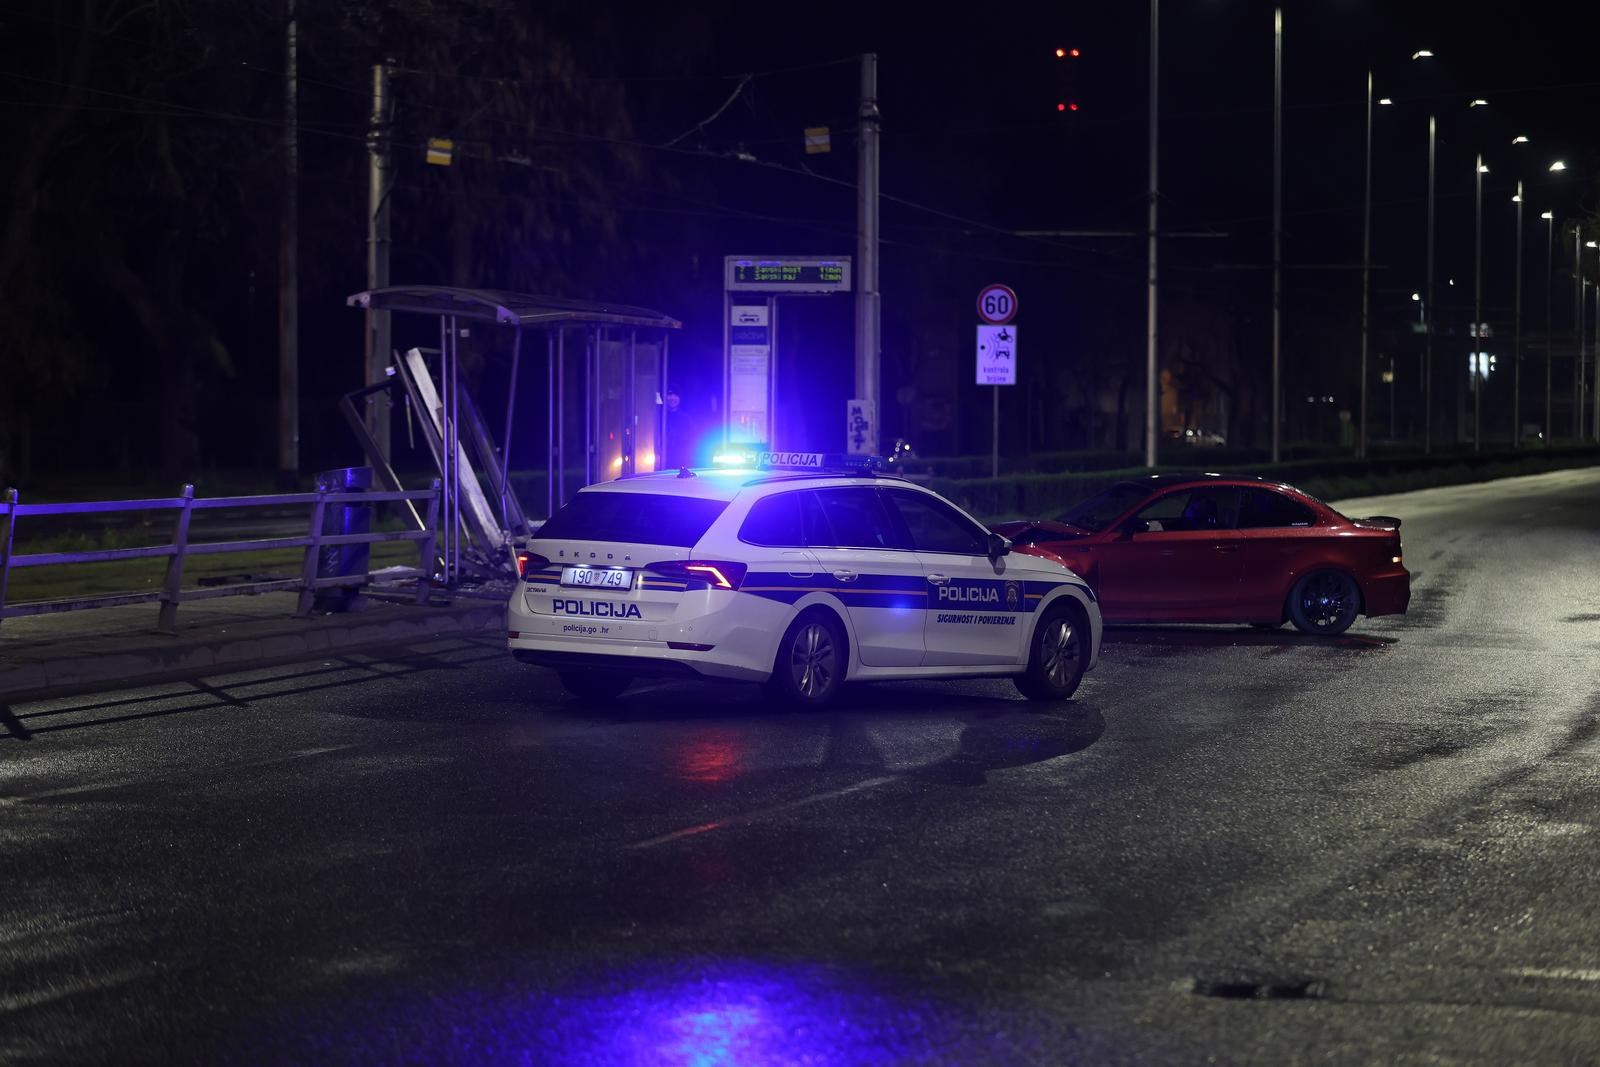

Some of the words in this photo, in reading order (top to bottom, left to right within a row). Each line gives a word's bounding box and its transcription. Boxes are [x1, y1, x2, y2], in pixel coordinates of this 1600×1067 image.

[985, 295, 1009, 315] 60
[762, 453, 818, 466] POLICIJA
[571, 570, 592, 584] 190
[600, 571, 623, 586] 749
[938, 586, 1000, 602] POLICIJA
[552, 599, 642, 619] POLICIJA
[937, 614, 974, 624] SIGURNOST
[977, 615, 1016, 625] POVJERENJE
